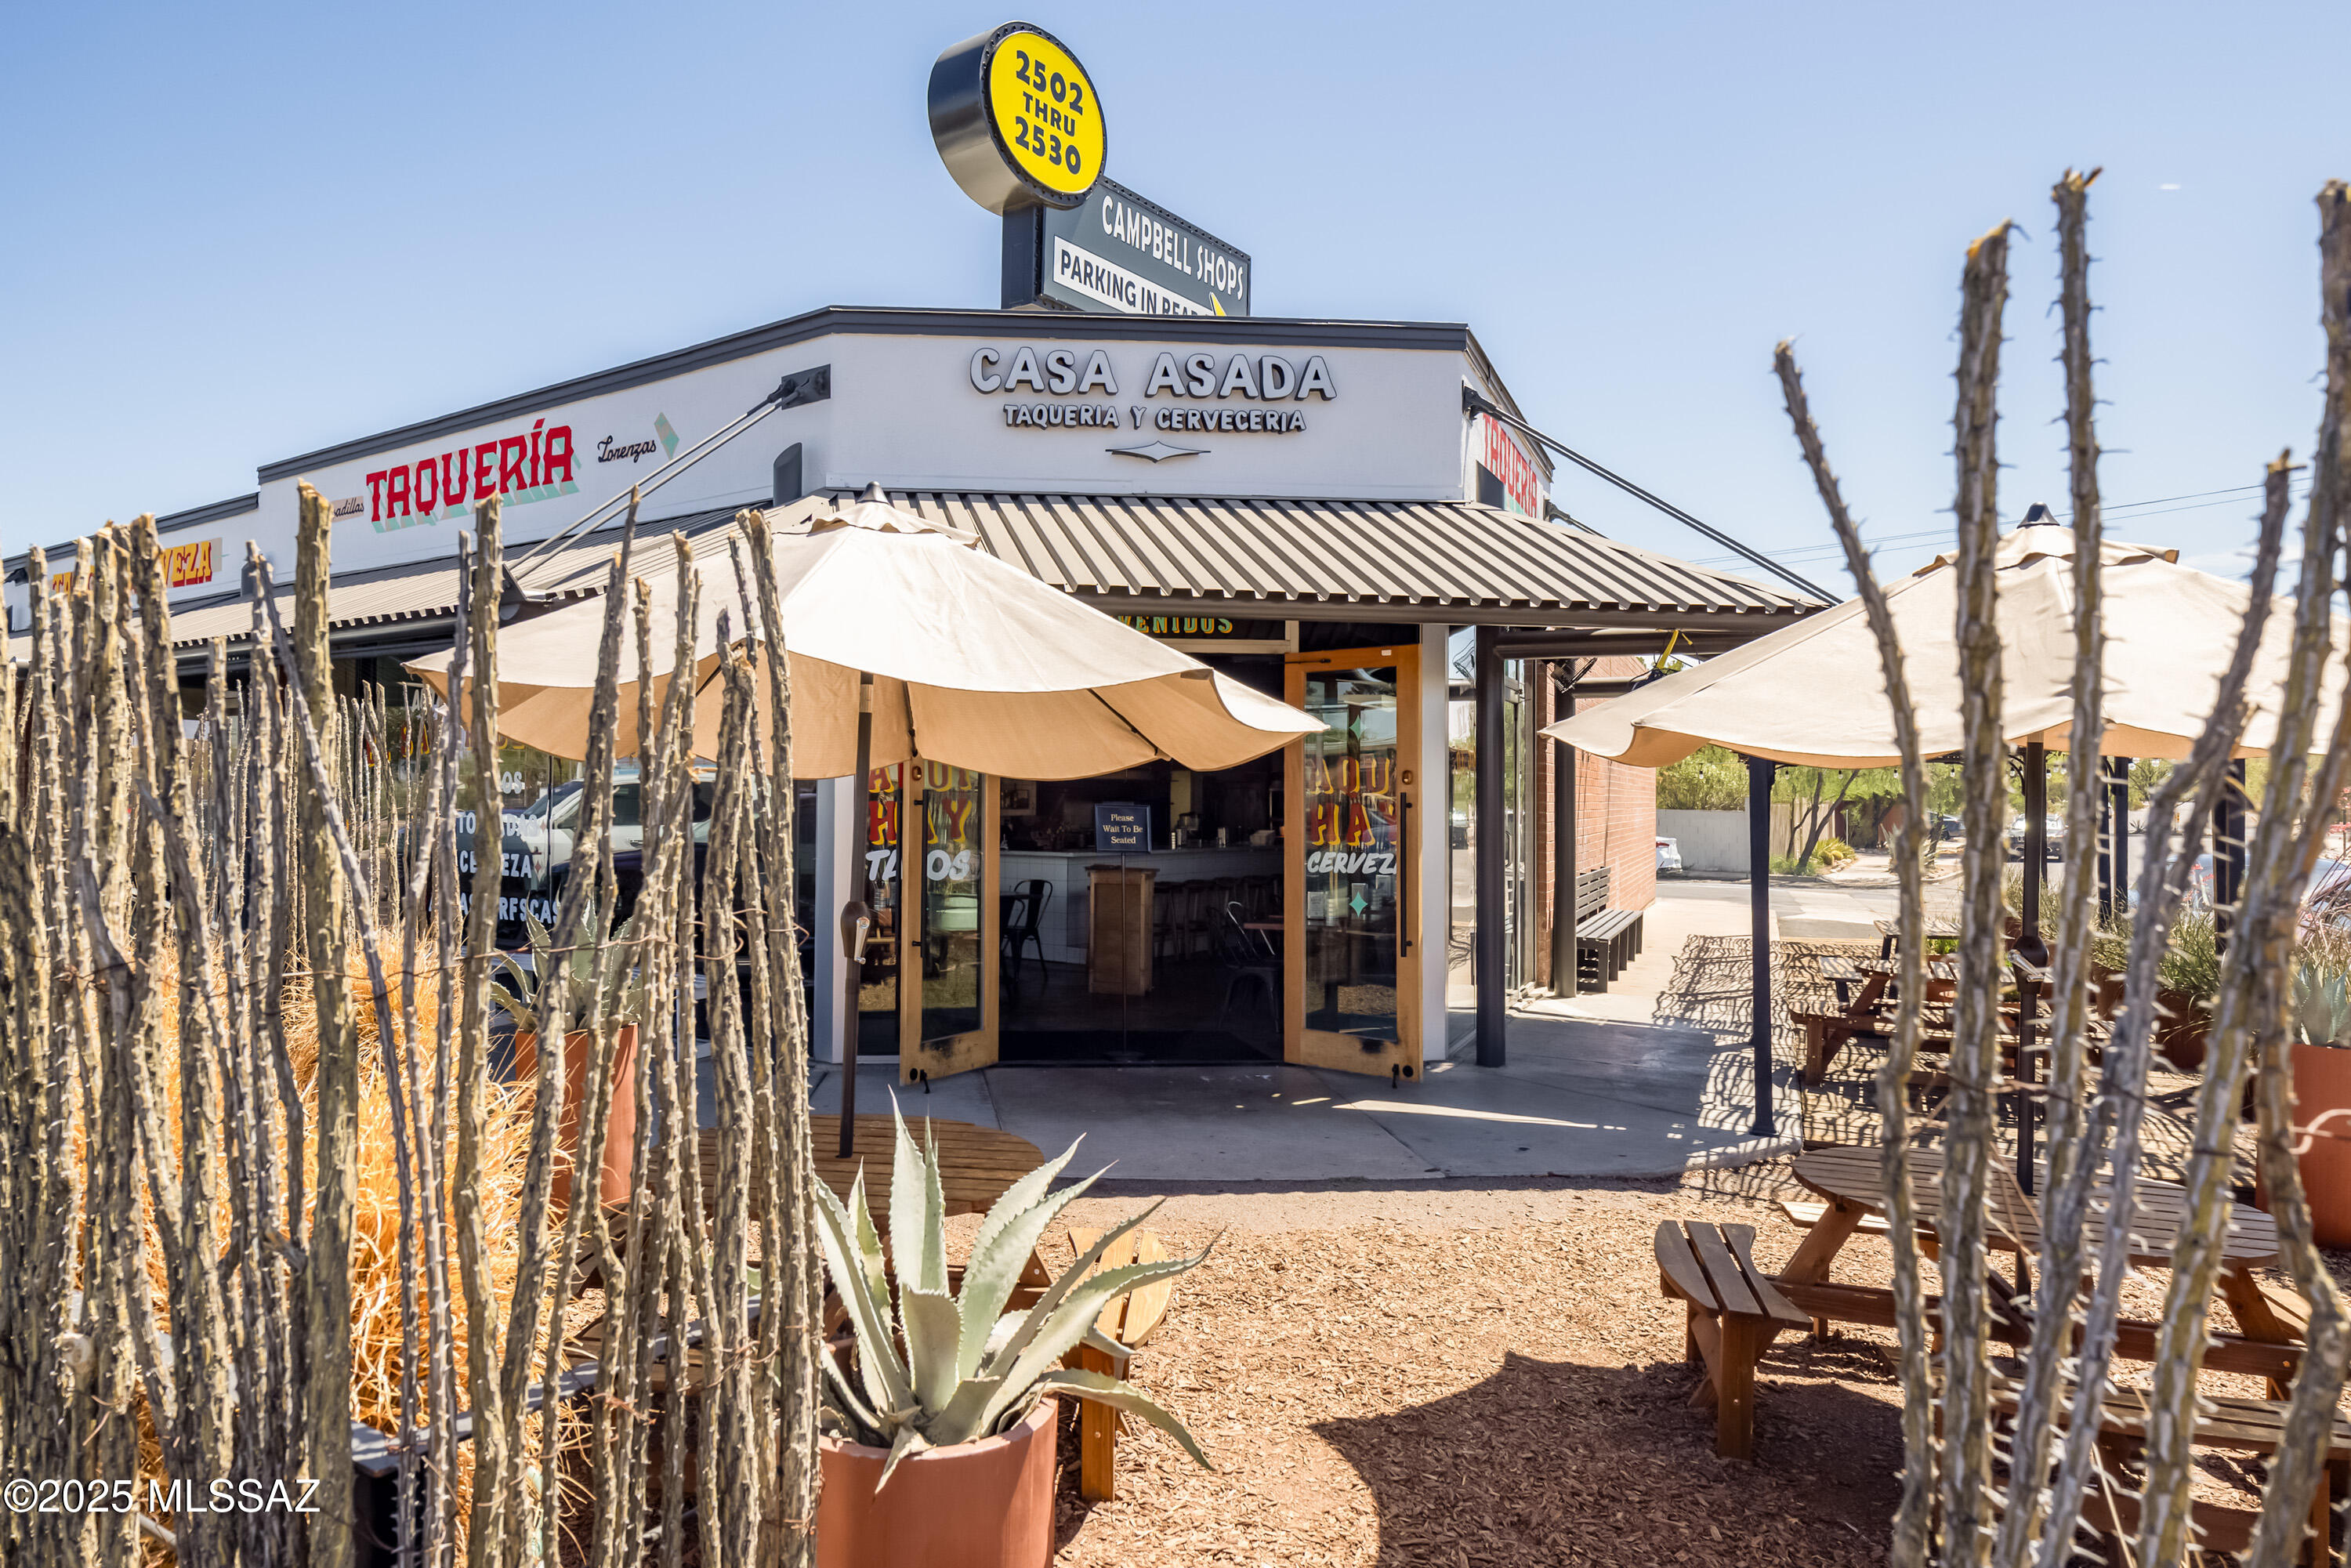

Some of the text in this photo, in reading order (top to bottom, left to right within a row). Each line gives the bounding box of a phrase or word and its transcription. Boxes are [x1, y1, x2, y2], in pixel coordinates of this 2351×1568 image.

[1016, 50, 1083, 115] 2502
[1023, 91, 1075, 137] THRU
[1015, 116, 1081, 176] 2530
[1102, 194, 1244, 301] CAMPBELL SHOPS
[1061, 248, 1198, 315] PARKING IN RE
[970, 346, 1337, 401] CASA ASADA
[1003, 404, 1307, 434] TAQUERIA Y CERVECERIA
[366, 418, 575, 525] TAQUERÍA
[597, 435, 657, 463] Lorenzas
[160, 541, 212, 588] VEZA
[1118, 616, 1233, 633] VENIDOS
[459, 850, 532, 878] CEEZA
[865, 849, 971, 882] TAOS
[1307, 851, 1396, 875] CERVEZ
